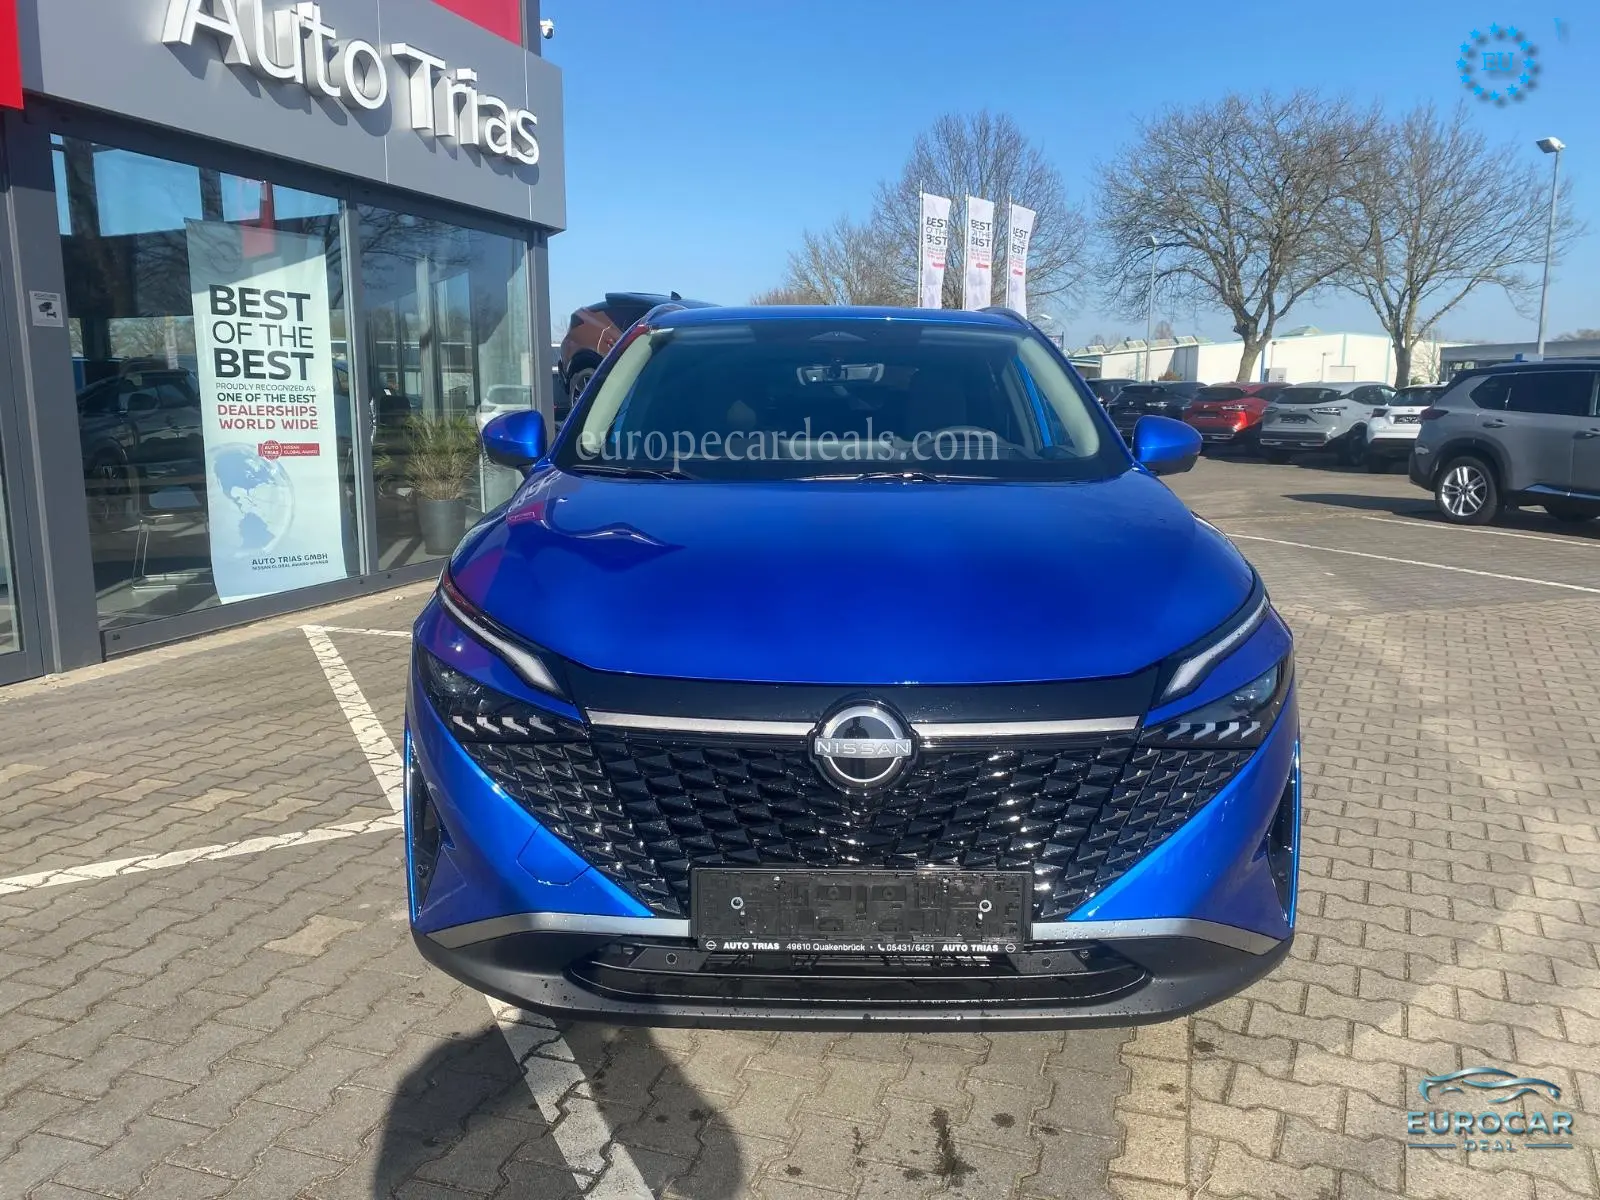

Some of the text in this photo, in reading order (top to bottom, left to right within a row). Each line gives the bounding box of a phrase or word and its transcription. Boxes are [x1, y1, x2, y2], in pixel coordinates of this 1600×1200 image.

[162, 0, 540, 165] Auto Trias
[209, 284, 311, 322] BEST
[212, 320, 314, 349] OF THE
[213, 347, 314, 381] BEST
[215, 382, 316, 392] PROUDLY RECOGNIZED AS
[217, 392, 317, 404] ONE OF THE BEST
[217, 404, 318, 417] DEALERSHIPS
[219, 418, 319, 430] WORLD WIDE
[252, 557, 276, 565] AUTO
[278, 555, 302, 563] TRIAS
[304, 553, 328, 561] GMBH
[817, 742, 909, 754] NISSAN
[723, 941, 999, 952] AUTO TRIAS 49610 Quakenbrück 05431/6421 AUTO TRIAS
